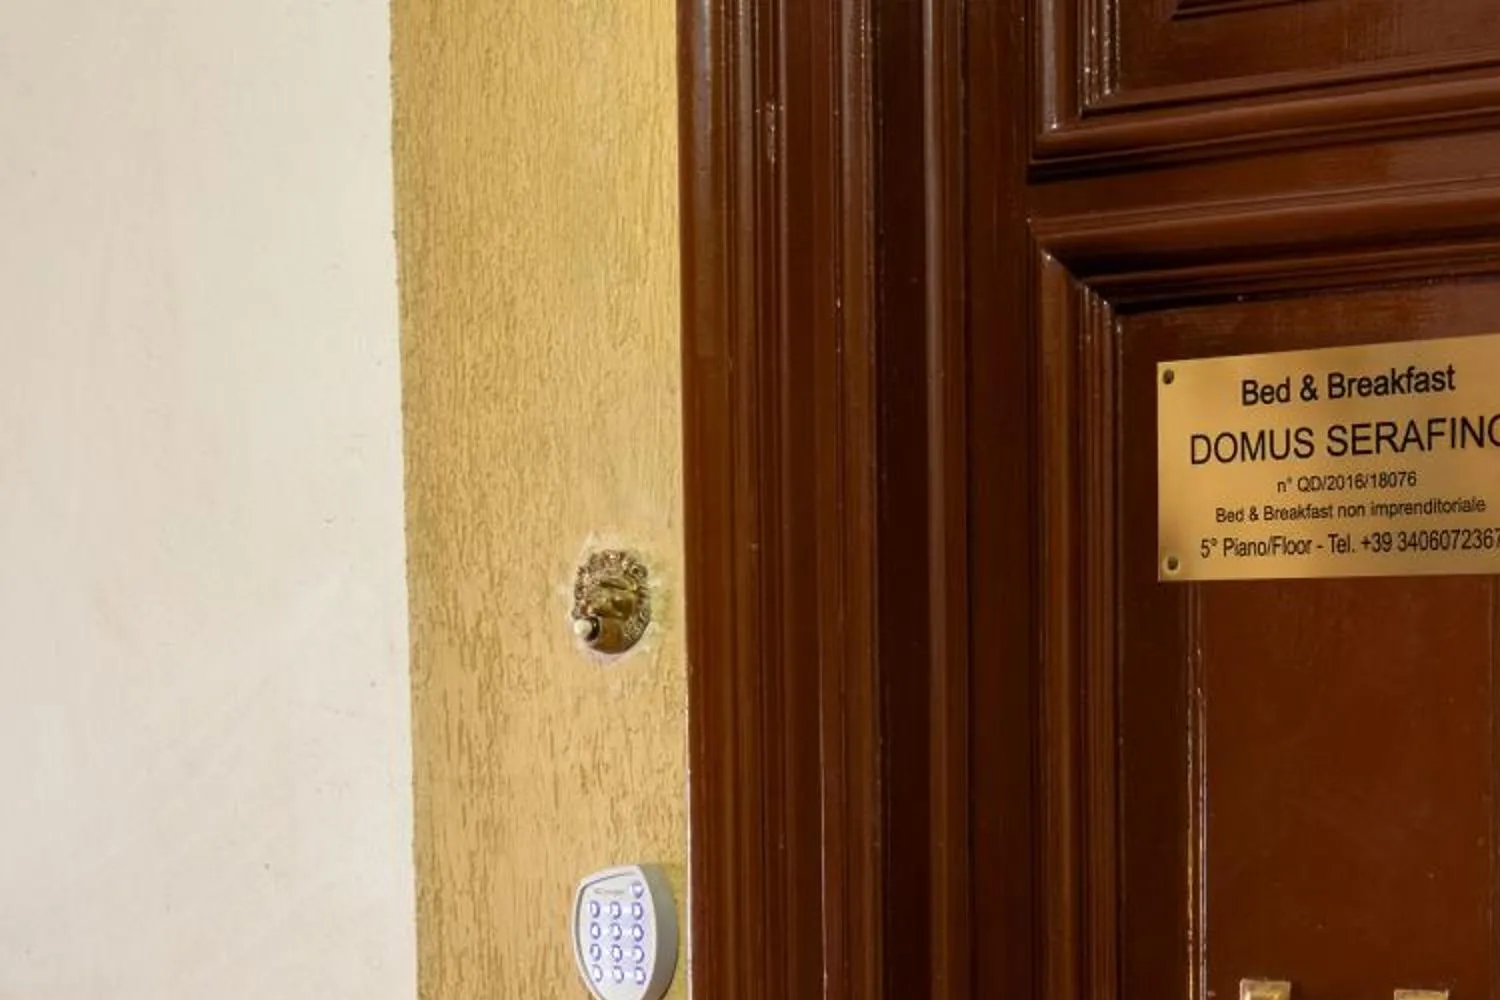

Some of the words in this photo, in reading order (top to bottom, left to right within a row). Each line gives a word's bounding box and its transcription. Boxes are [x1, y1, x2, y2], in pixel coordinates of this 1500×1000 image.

[1242, 377, 1291, 405] Bed
[1300, 375, 1318, 402] &
[1328, 364, 1456, 399] Breakfast
[1191, 427, 1315, 464] DOMUS
[1297, 471, 1417, 492] QD/2016/18076
[1216, 506, 1244, 523] Bed
[1249, 506, 1259, 521] &
[1263, 504, 1332, 520] Breakfast
[1337, 505, 1365, 518] non
[1371, 496, 1486, 518] imprenditoriale
[1224, 535, 1312, 557] Piano/Floor
[1328, 533, 1356, 552] Tel.
[1361, 533, 1392, 552] +39
